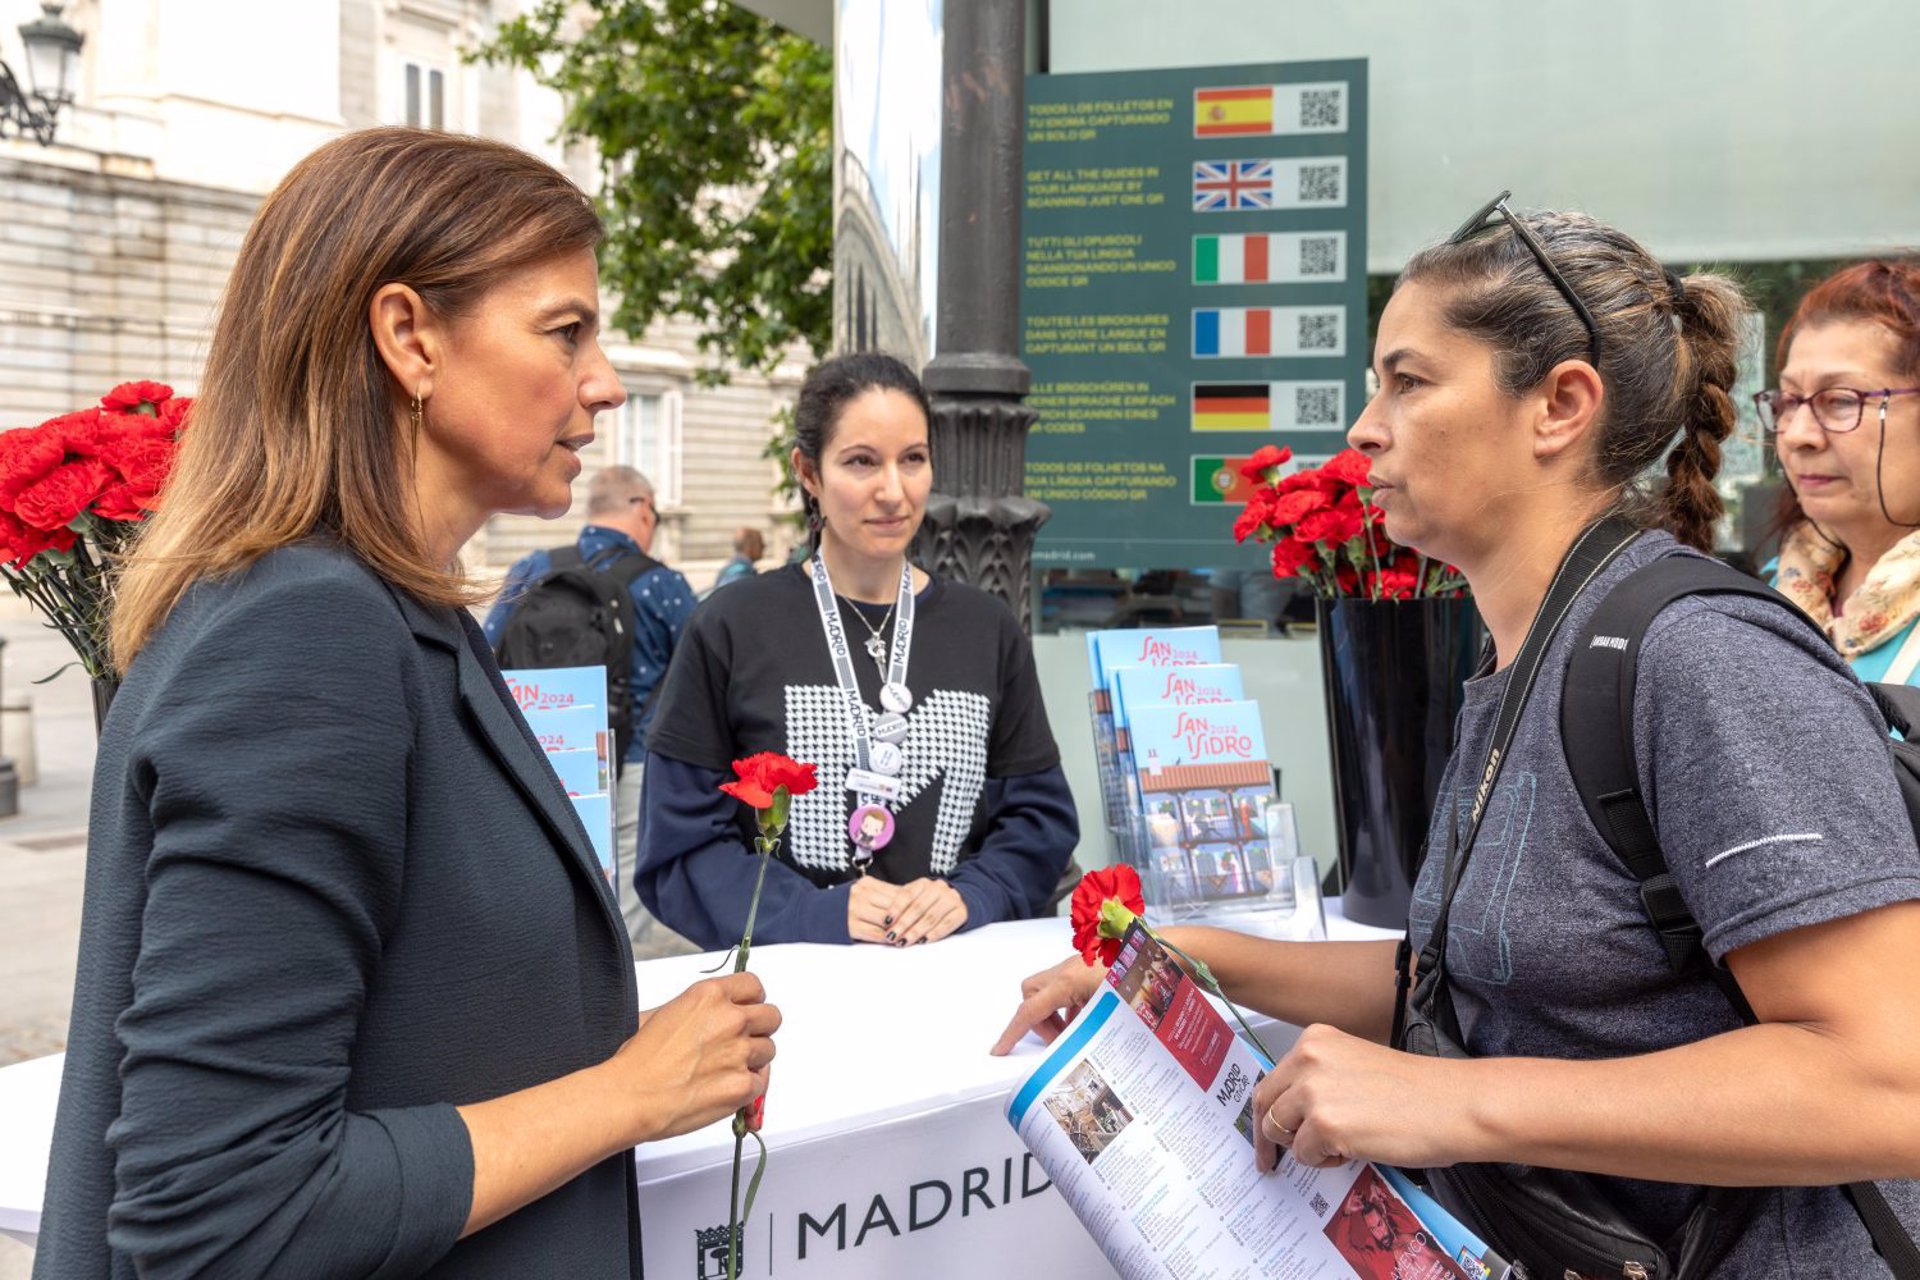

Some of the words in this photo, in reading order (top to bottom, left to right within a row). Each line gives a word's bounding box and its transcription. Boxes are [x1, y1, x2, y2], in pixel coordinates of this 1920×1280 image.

[1029, 103, 1068, 115] TODOS
[1070, 102, 1093, 113] LOS
[1095, 100, 1155, 113] FOLLETOS
[1157, 99, 1174, 110] EN
[1029, 117, 1044, 128] TU
[1046, 116, 1085, 128] IDIOMA
[1088, 113, 1170, 126] CAPTURANDO
[1027, 130, 1044, 141] UN
[1047, 129, 1077, 141] SOLO
[1027, 170, 1050, 182] GET
[1052, 169, 1074, 180] ALL
[1077, 168, 1099, 179] THE
[1102, 167, 1143, 179] GUIDES
[1146, 166, 1159, 177] IN
[1028, 182, 1059, 194] YOUR
[1061, 180, 1124, 193] LANGUAGE
[1126, 180, 1143, 191] BY
[1027, 195, 1087, 208] SCANNING
[1089, 193, 1118, 206] JUST
[1120, 193, 1144, 204] ONE
[1028, 236, 1061, 248] TUTTI
[1063, 236, 1081, 247] GLI
[1083, 234, 1143, 246] OPUSCOLI
[1026, 249, 1063, 261] NELLA
[1065, 248, 1089, 260] TUA
[1091, 247, 1135, 260] LINGUA
[1120, 261, 1137, 272] UN
[1139, 259, 1176, 272] UNICO
[1025, 275, 1069, 287] CODICE
[1027, 315, 1071, 328] TOUTES
[1073, 315, 1094, 327] LES
[1097, 314, 1169, 327] BROCHURES
[1025, 328, 1057, 341] DANS
[1060, 328, 1098, 340] VOTRE
[1100, 327, 1147, 340] LANGUE
[1149, 327, 1166, 339] EN
[1025, 341, 1096, 354] CAPTURANT
[1098, 341, 1115, 353] UN
[1117, 340, 1146, 353] SEUL
[1137, 382, 1150, 393] IN
[1068, 395, 1122, 407] SPRACHE
[1124, 395, 1176, 407] EINFACH
[1039, 408, 1066, 420] RCH
[1068, 408, 1122, 420] SCANNEN
[1025, 462, 1064, 474] TODOS
[1066, 462, 1082, 474] OS
[1084, 461, 1147, 474] FOLHETOS
[1148, 462, 1166, 474] NA
[1094, 475, 1177, 488] CAPTURANDO
[826, 611, 847, 656] MADRID
[893, 619, 908, 665] MADRID
[1138, 636, 1172, 662] SAN
[505, 678, 539, 704] AN
[541, 693, 575, 704] 2024
[1161, 673, 1196, 699] SAN
[846, 689, 867, 738] MADRID
[1172, 712, 1209, 739] SAN
[538, 734, 565, 746] 024
[1187, 732, 1253, 760] ISIDRO
[1471, 748, 1501, 823] Nikon
[1216, 1062, 1242, 1107] MADRID
[798, 1151, 1053, 1260] MADRID
